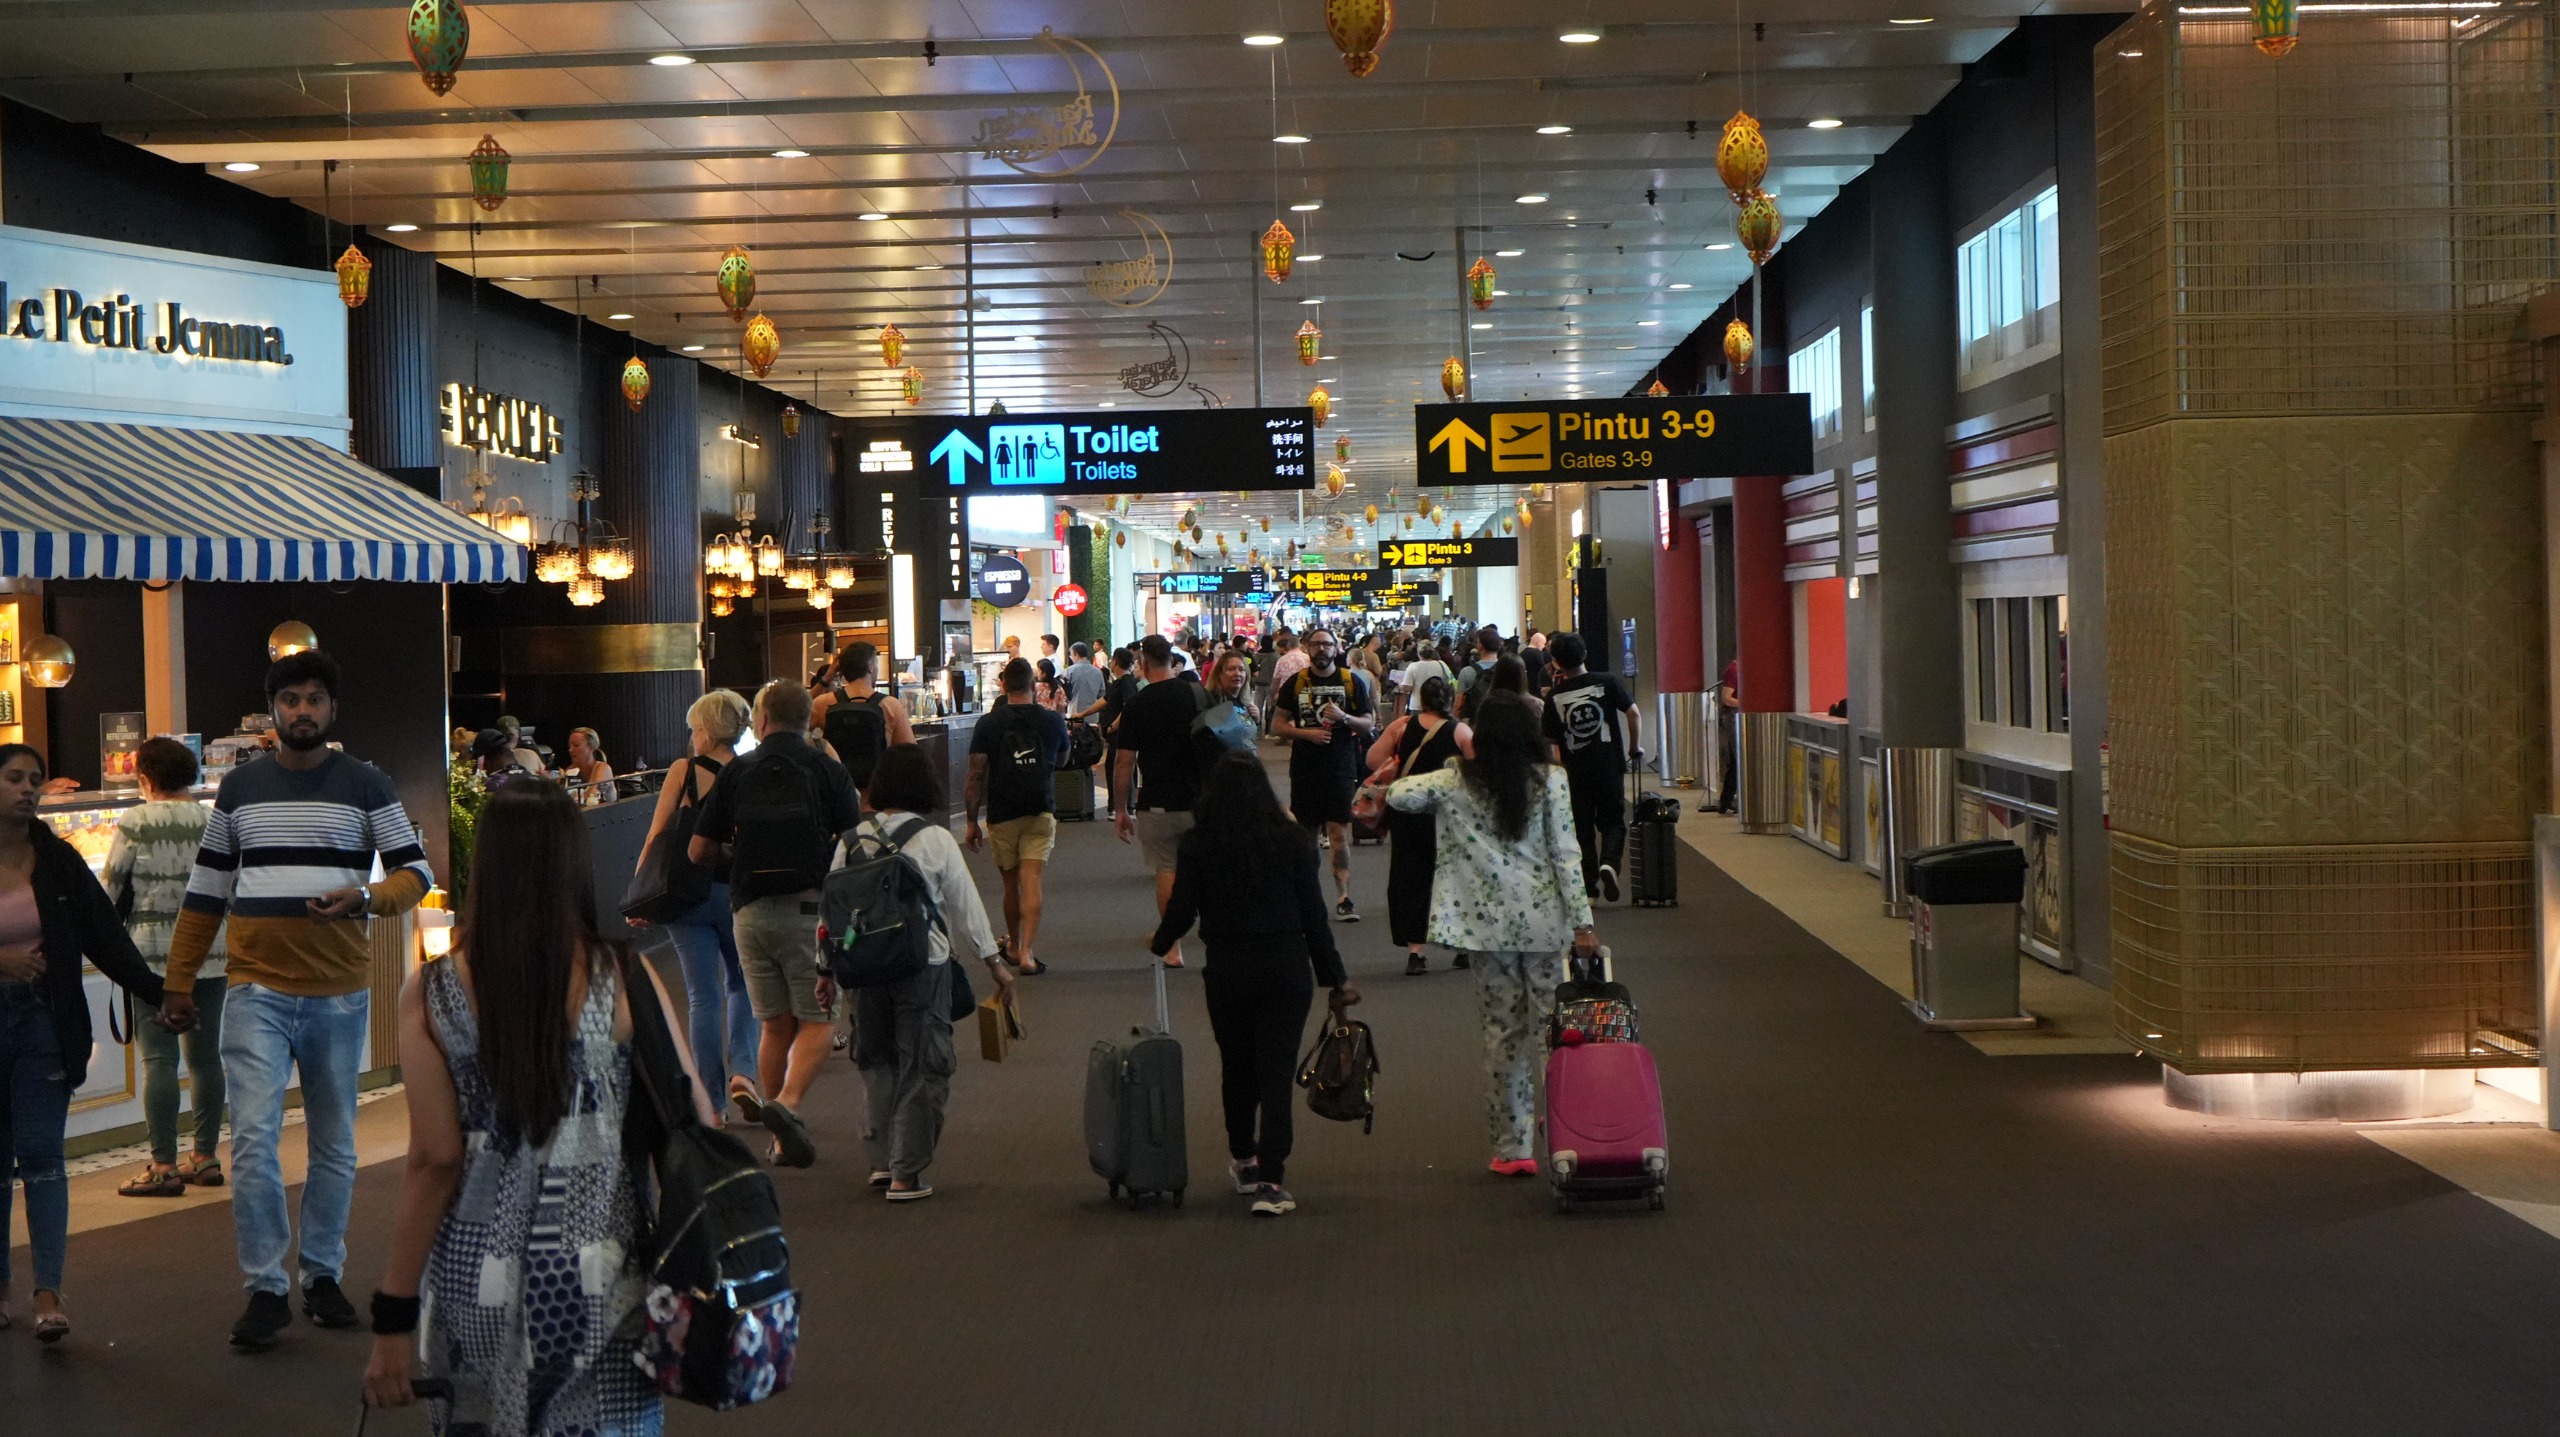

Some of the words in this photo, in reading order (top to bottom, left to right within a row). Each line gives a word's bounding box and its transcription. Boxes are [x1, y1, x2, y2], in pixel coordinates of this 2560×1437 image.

[0, 280, 45, 338] Le
[54, 288, 148, 351] Petit
[1558, 412, 1651, 442] Pintu
[1661, 409, 1716, 439] 3-9
[1070, 425, 1160, 454] Toilet
[1272, 433, 1304, 445] 洗手间
[1276, 448, 1304, 459] トイレ
[1560, 451, 1616, 469] Gates
[1622, 450, 1653, 468] 3-9
[1071, 461, 1138, 481] Toilets
[1275, 464, 1305, 476] 화장실
[1427, 543, 1461, 555] Pintu
[1464, 542, 1473, 554] 3
[949, 532, 961, 592] AWAY
[1428, 557, 1445, 565] Gate
[984, 570, 1022, 582] ESPRESSO
[1199, 575, 1223, 584] Toilet
[1324, 573, 1350, 581] Pintu
[1352, 572, 1368, 581] 4-9
